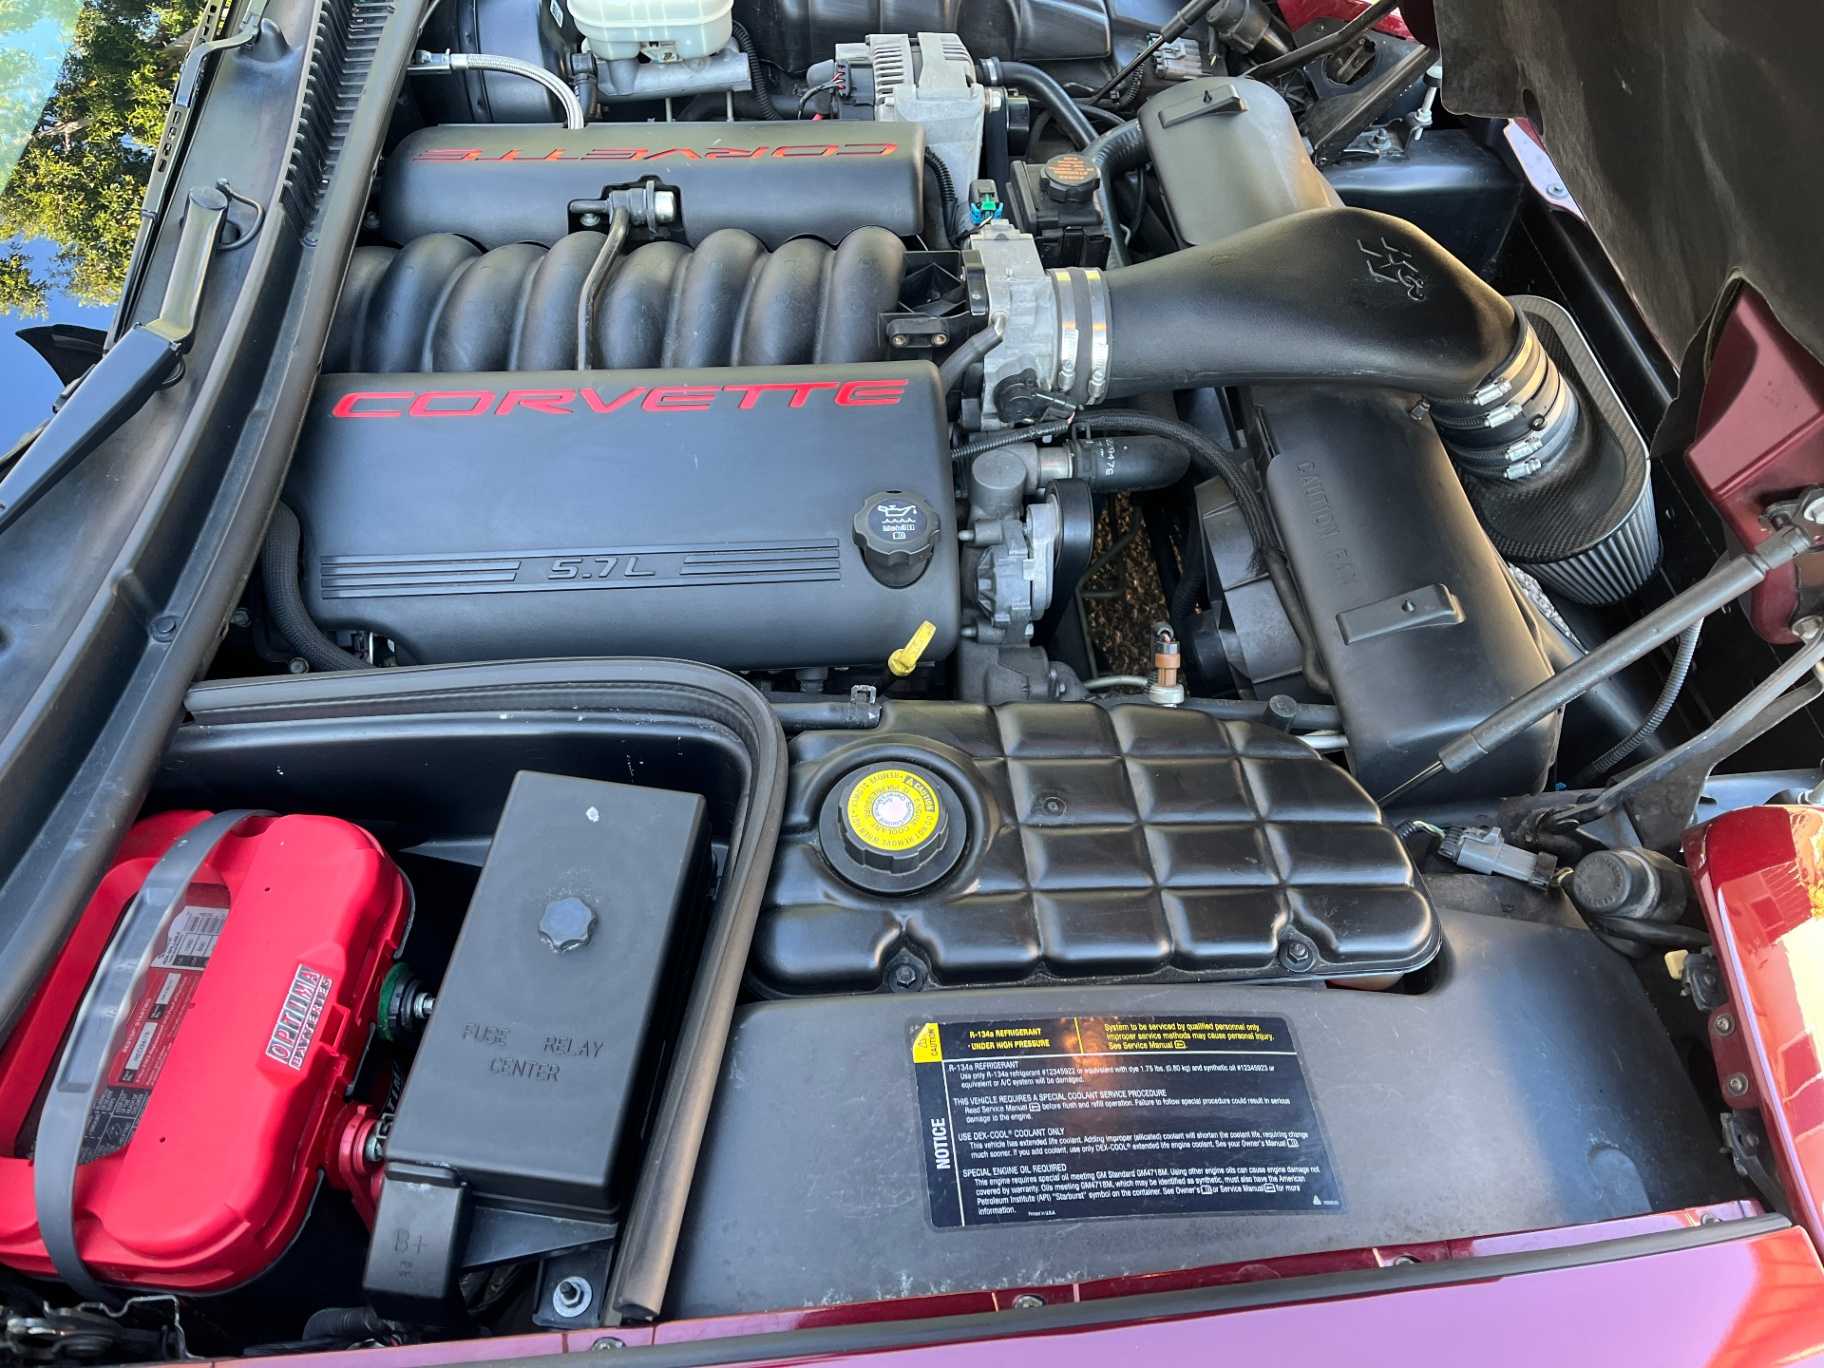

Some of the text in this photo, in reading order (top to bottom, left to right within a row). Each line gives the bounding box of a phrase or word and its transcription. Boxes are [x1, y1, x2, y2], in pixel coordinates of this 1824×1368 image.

[412, 144, 897, 161] CORVETTE
[330, 380, 909, 419] CORVETTE
[547, 556, 656, 580] 5.7L
[270, 966, 321, 1061] OPTIMA
[291, 977, 333, 1067] BATTERIES
[1104, 1023, 1129, 1031] System
[1148, 1023, 1176, 1031] serviced
[1186, 1023, 1213, 1031] qualified
[461, 1023, 604, 1058] FUSE RELAY
[1137, 1033, 1161, 1041] service
[1122, 1041, 1147, 1049] Service
[488, 1058, 561, 1082] CENTER
[974, 1061, 1019, 1069] REFRIGERANT
[953, 1097, 968, 1105] THIS
[969, 1096, 997, 1104] VEHICLE
[998, 1094, 1031, 1103] REQUIRES
[1038, 1093, 1065, 1101] SPECIAL
[1067, 1091, 1097, 1100] COOLANT
[1099, 1090, 1126, 1098] SERVICE
[1014, 1129, 1046, 1137] COOLANT
[1047, 1128, 1065, 1136] ONLY
[931, 1118, 950, 1170] NOTICE
[962, 1168, 991, 1177] SPECIAL
[992, 1166, 1018, 1175] ENGINE
[1032, 1164, 1067, 1173] REQUIRED
[1011, 1175, 1036, 1184] requires
[1219, 1185, 1241, 1193] Service
